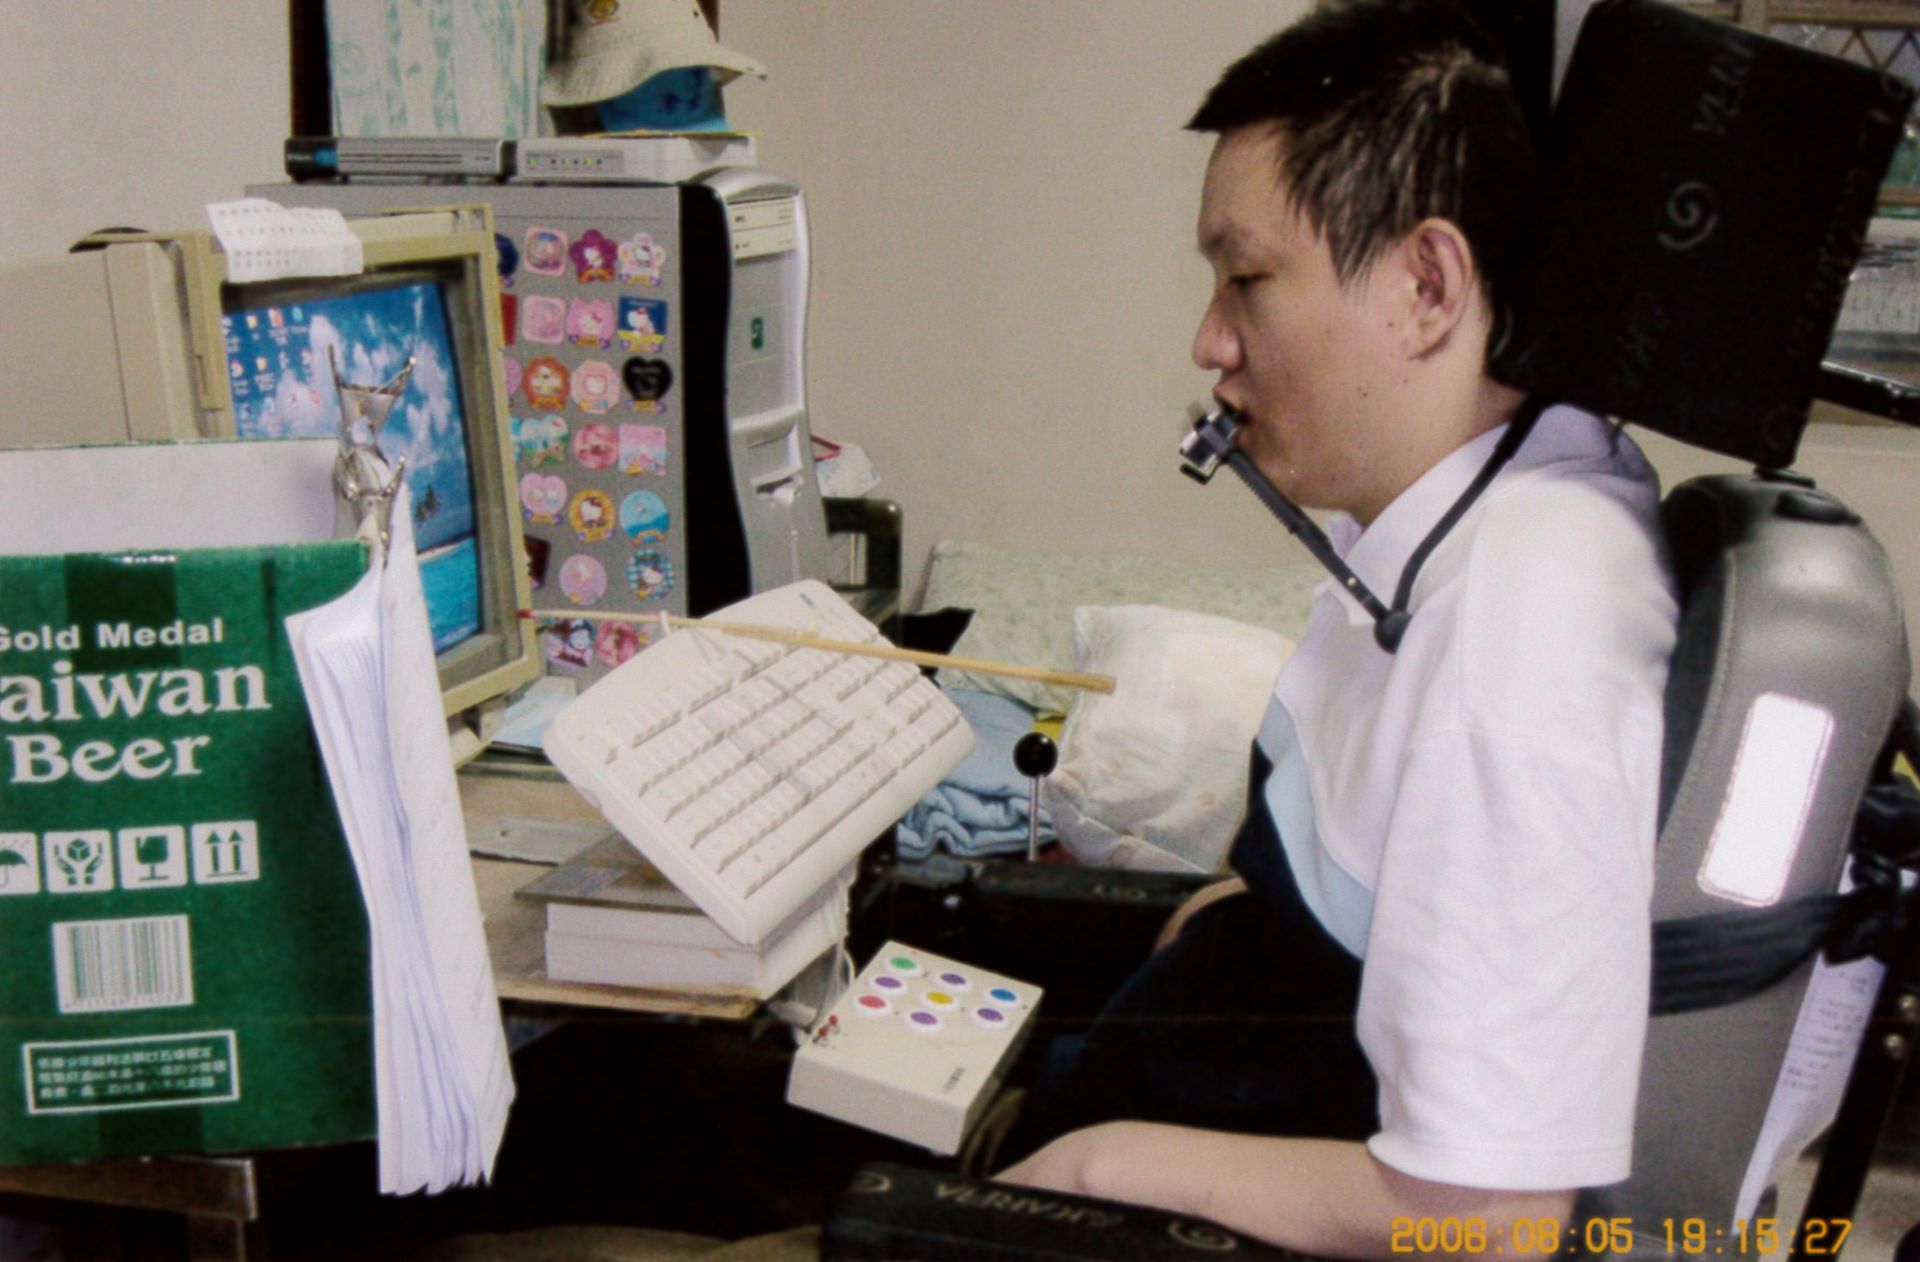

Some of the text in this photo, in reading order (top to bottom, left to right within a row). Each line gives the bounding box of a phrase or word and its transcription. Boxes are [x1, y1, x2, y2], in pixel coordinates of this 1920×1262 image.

[98, 617, 224, 648] Medal
[0, 660, 272, 722] aiwan
[6, 734, 212, 784] Beer
